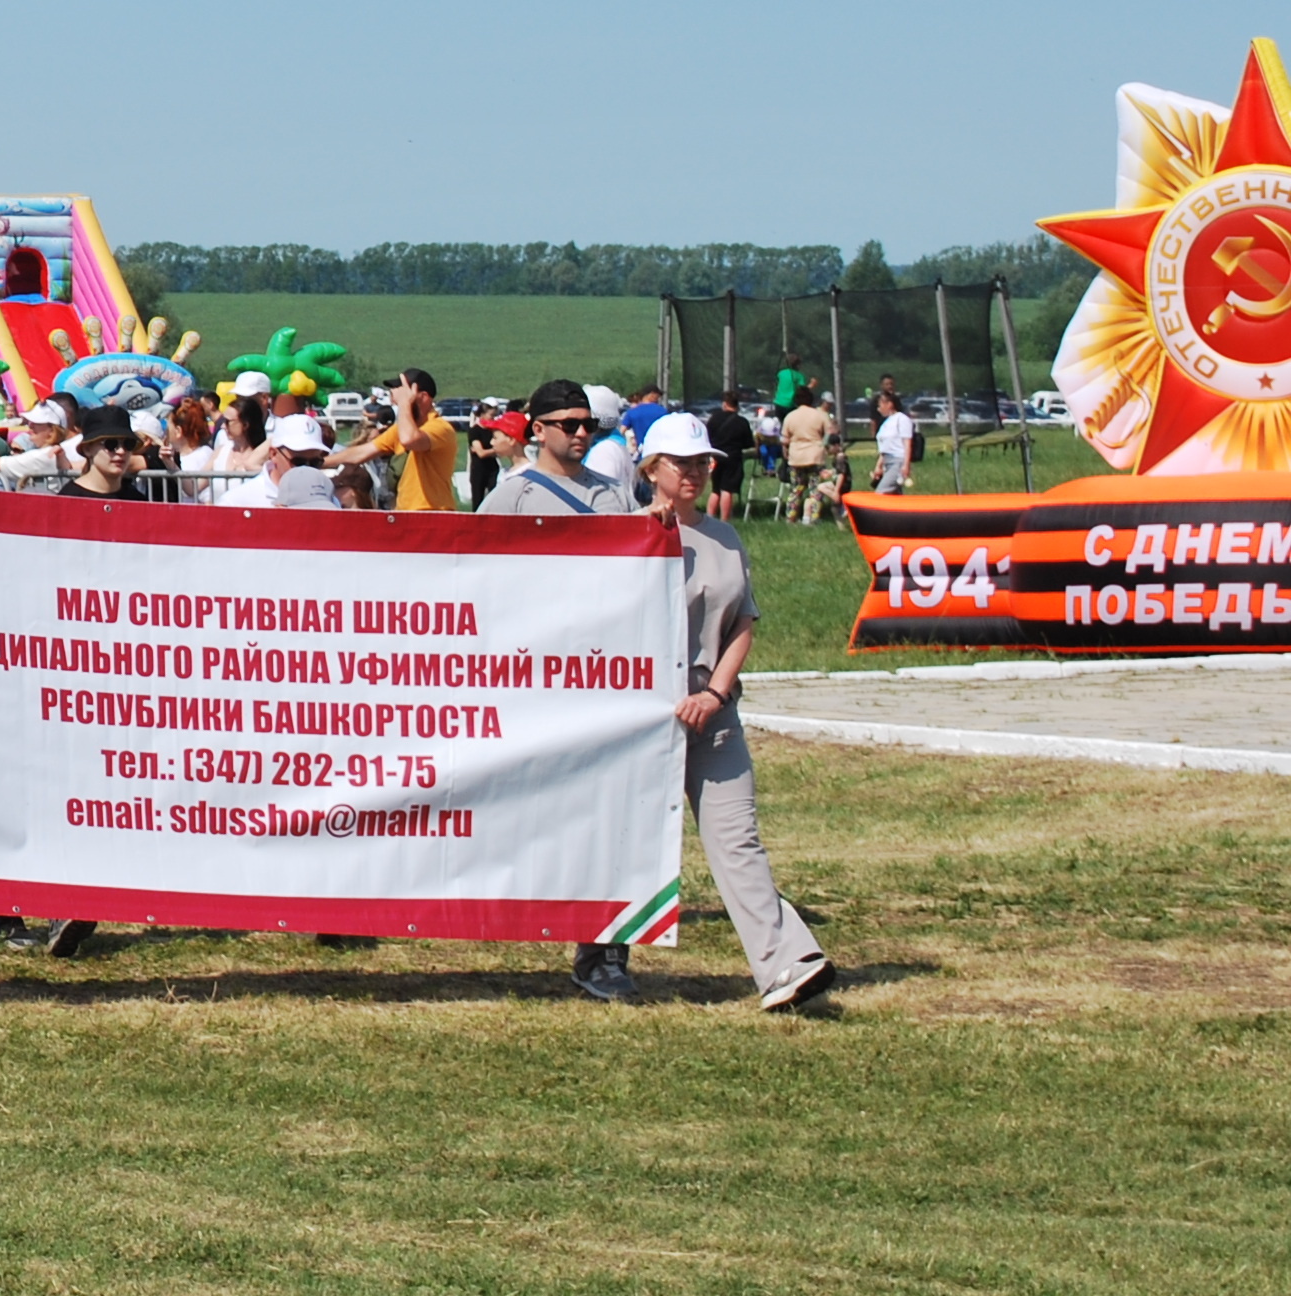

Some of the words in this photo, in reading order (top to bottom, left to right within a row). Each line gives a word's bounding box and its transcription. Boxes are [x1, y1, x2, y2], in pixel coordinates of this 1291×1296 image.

[1084, 523, 1115, 566] С
[57, 587, 120, 624] МАУ
[129, 592, 343, 633] СПОРТИВНАЯ
[353, 601, 478, 636] ШКОЛА
[202, 641, 330, 684] РАЙОНА
[337, 647, 533, 689] УФИМСКИЙ
[543, 648, 653, 690] РАЙОН
[41, 687, 244, 733] РЕСПУБЛИКИ
[253, 700, 502, 739] БАШКОРТОСТА
[100, 748, 175, 780] тел.:
[184, 748, 263, 785] (347)
[272, 752, 437, 789] 282-91-75
[66, 797, 163, 832] email:
[171, 800, 473, 838] sdusshor@mail.ru
